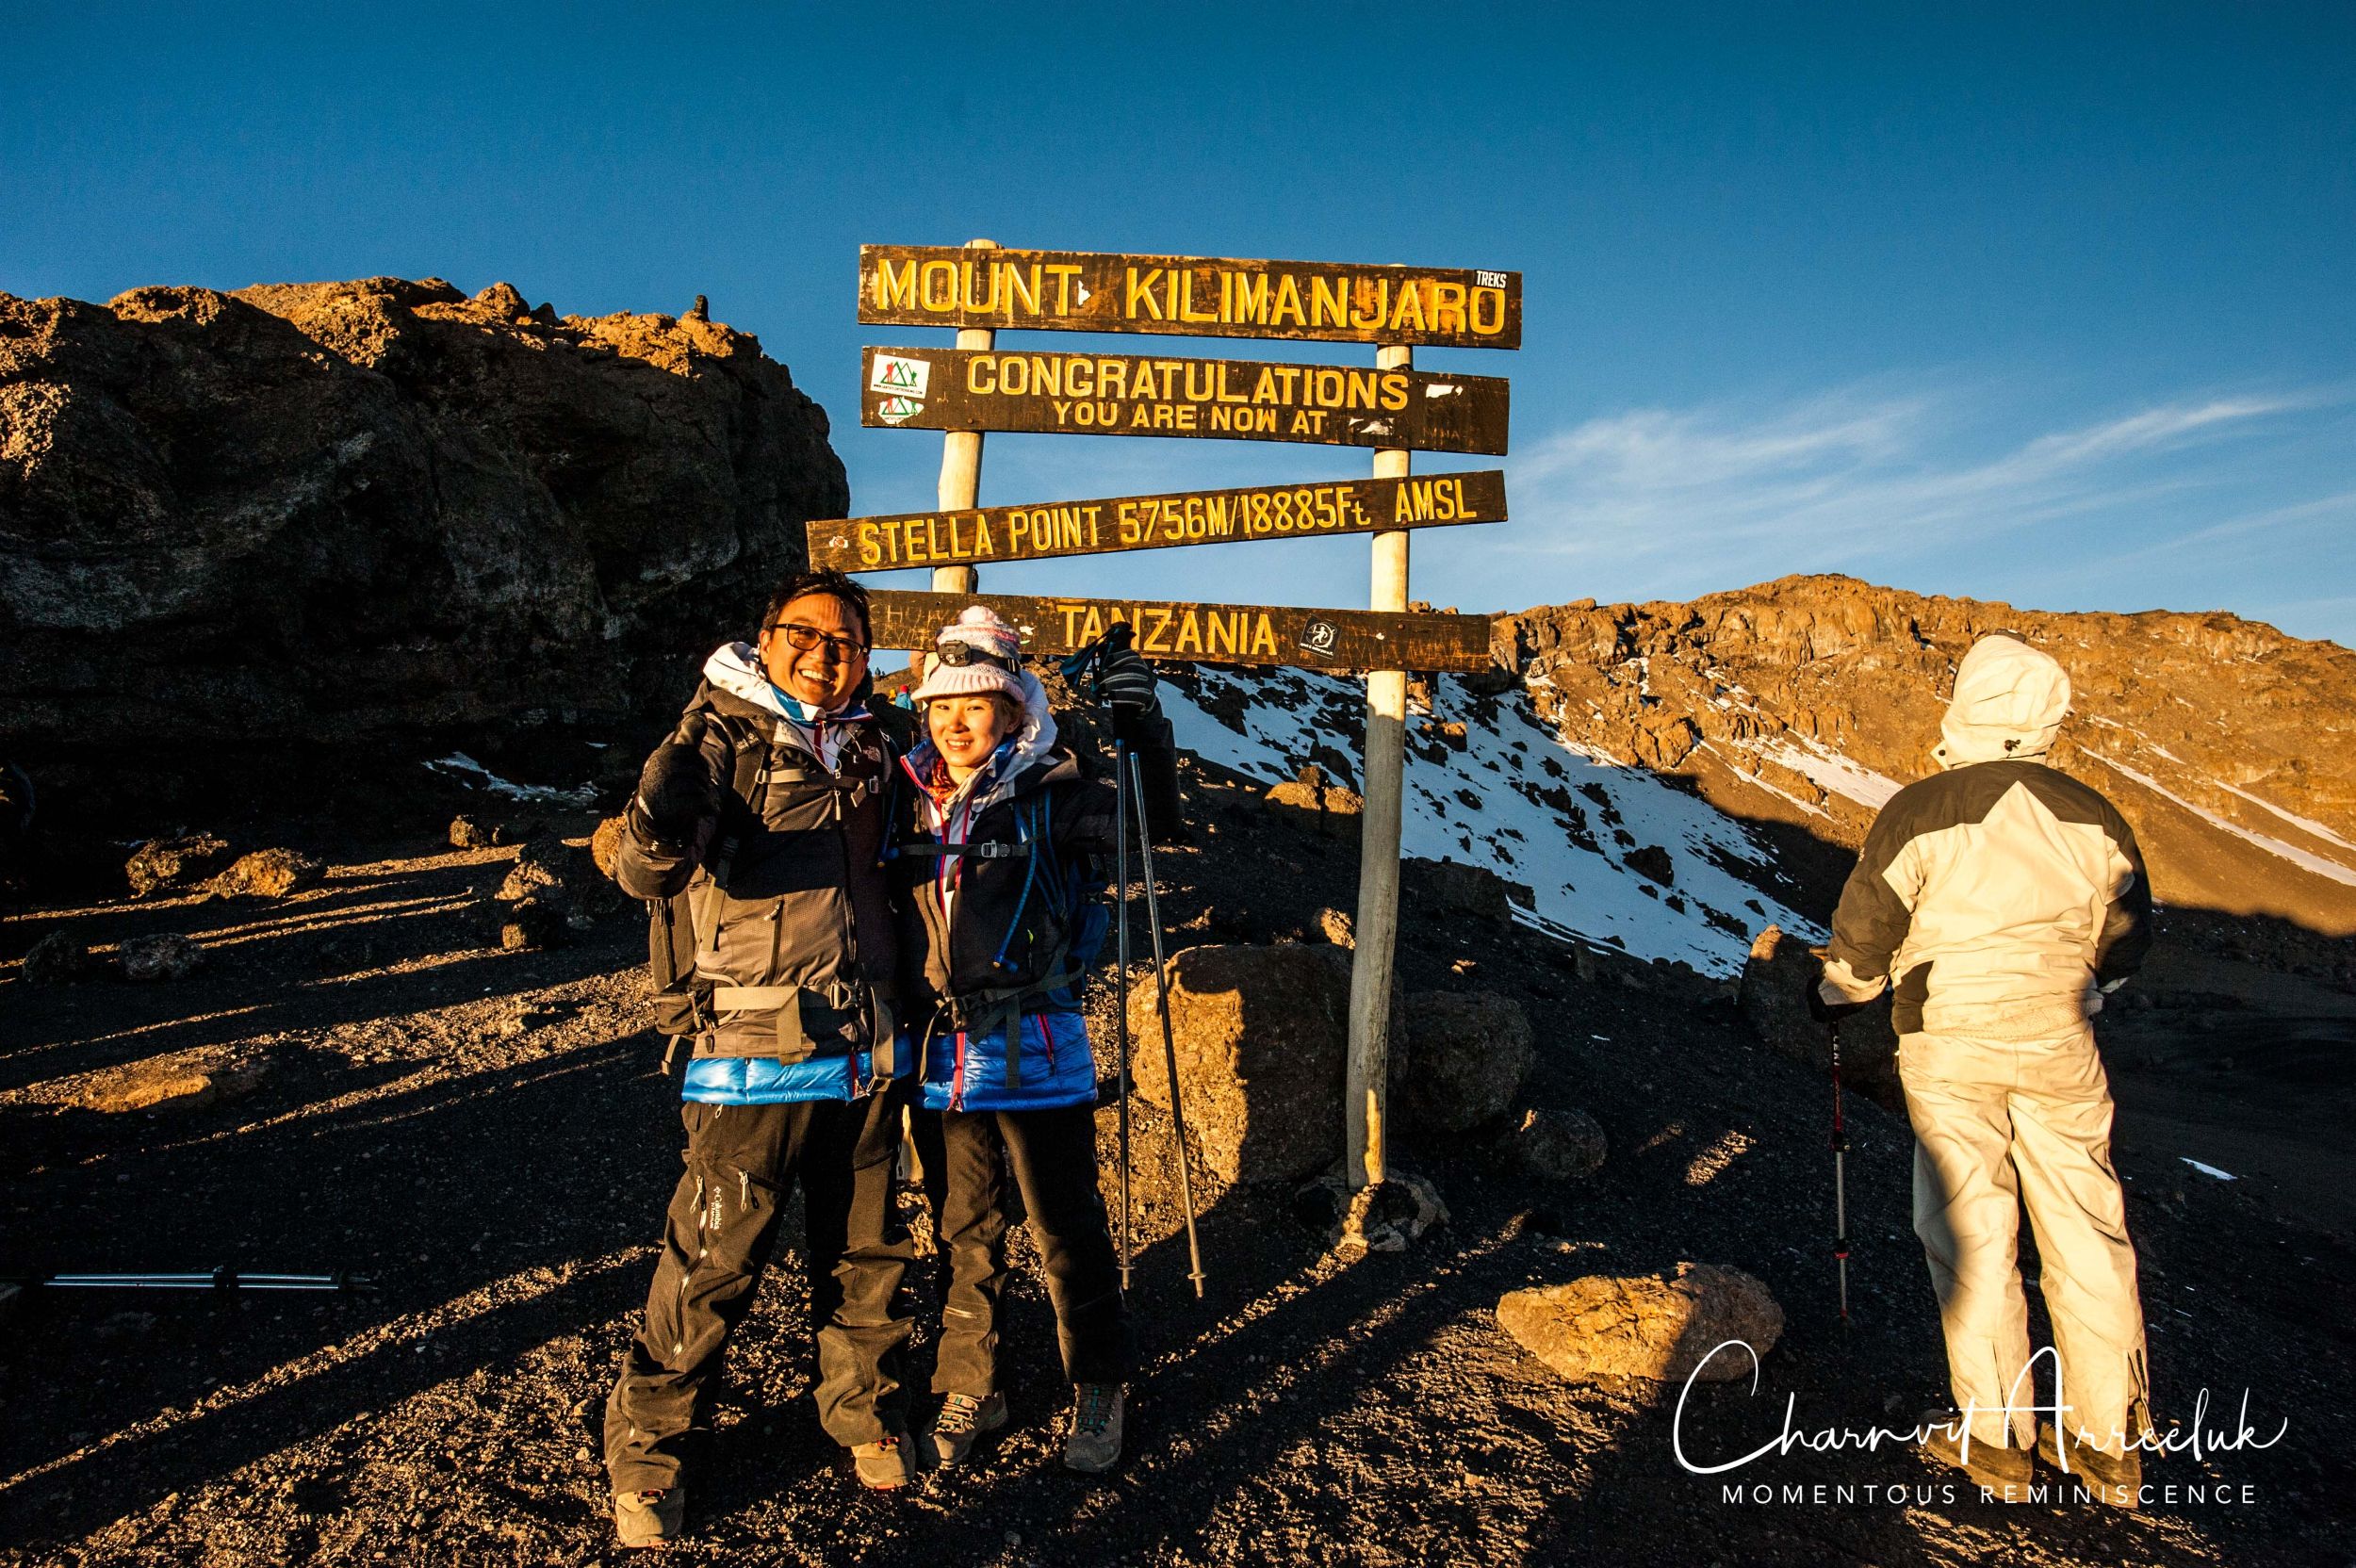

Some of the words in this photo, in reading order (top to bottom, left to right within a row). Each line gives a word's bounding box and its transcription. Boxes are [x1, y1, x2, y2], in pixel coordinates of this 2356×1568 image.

[876, 259, 1084, 316] MOUNT
[1125, 268, 1506, 335] KILIMANJARO
[1476, 270, 1507, 288] TREKS
[967, 354, 1410, 411] CONGRATULATIONS
[1052, 400, 1119, 427] YOU
[1133, 403, 1197, 430] ARE
[1213, 405, 1277, 433] NOW
[1291, 410, 1328, 435] AT
[859, 514, 994, 565] STELLA
[1008, 506, 1103, 553] POINT
[1395, 479, 1478, 522] AMSL
